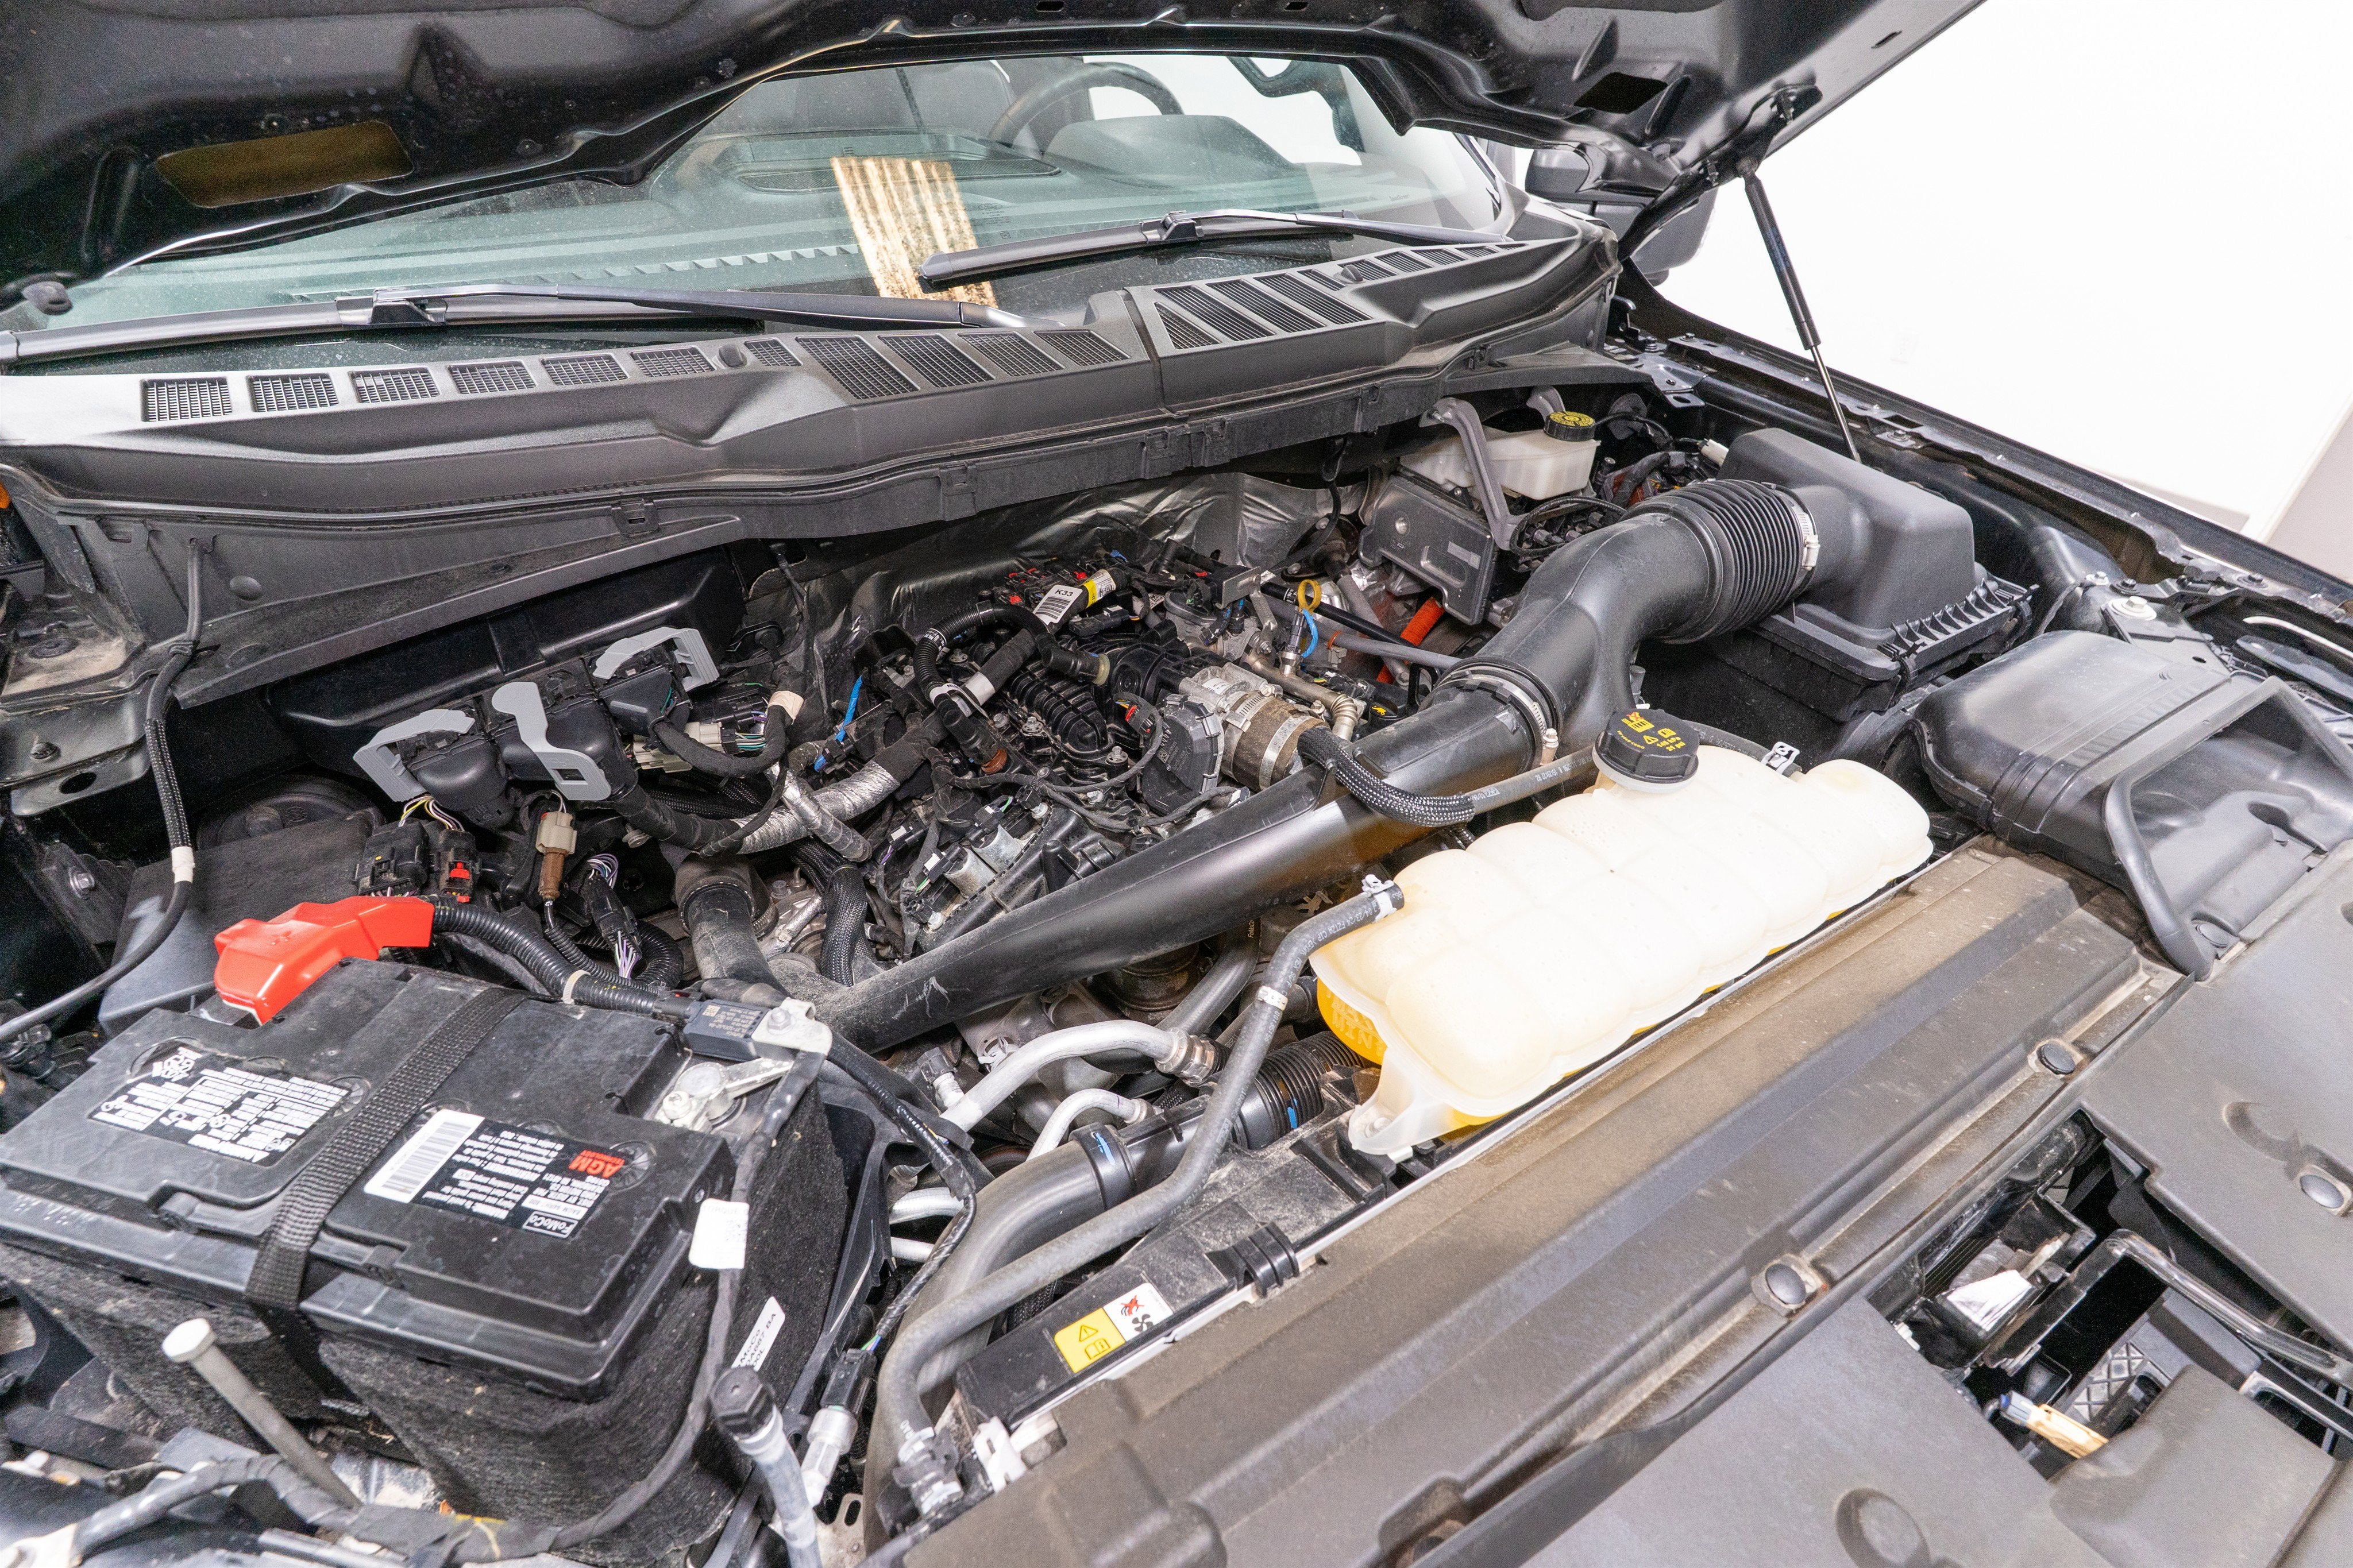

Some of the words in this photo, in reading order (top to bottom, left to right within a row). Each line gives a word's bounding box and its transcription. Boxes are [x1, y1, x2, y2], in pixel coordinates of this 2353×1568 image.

[1054, 588, 1074, 597] K33
[1347, 907, 1373, 926] 04/23/24
[1332, 1010, 1374, 1049] MIN
[567, 1154, 620, 1179] AGM
[526, 1214, 574, 1233] FoMoCo
